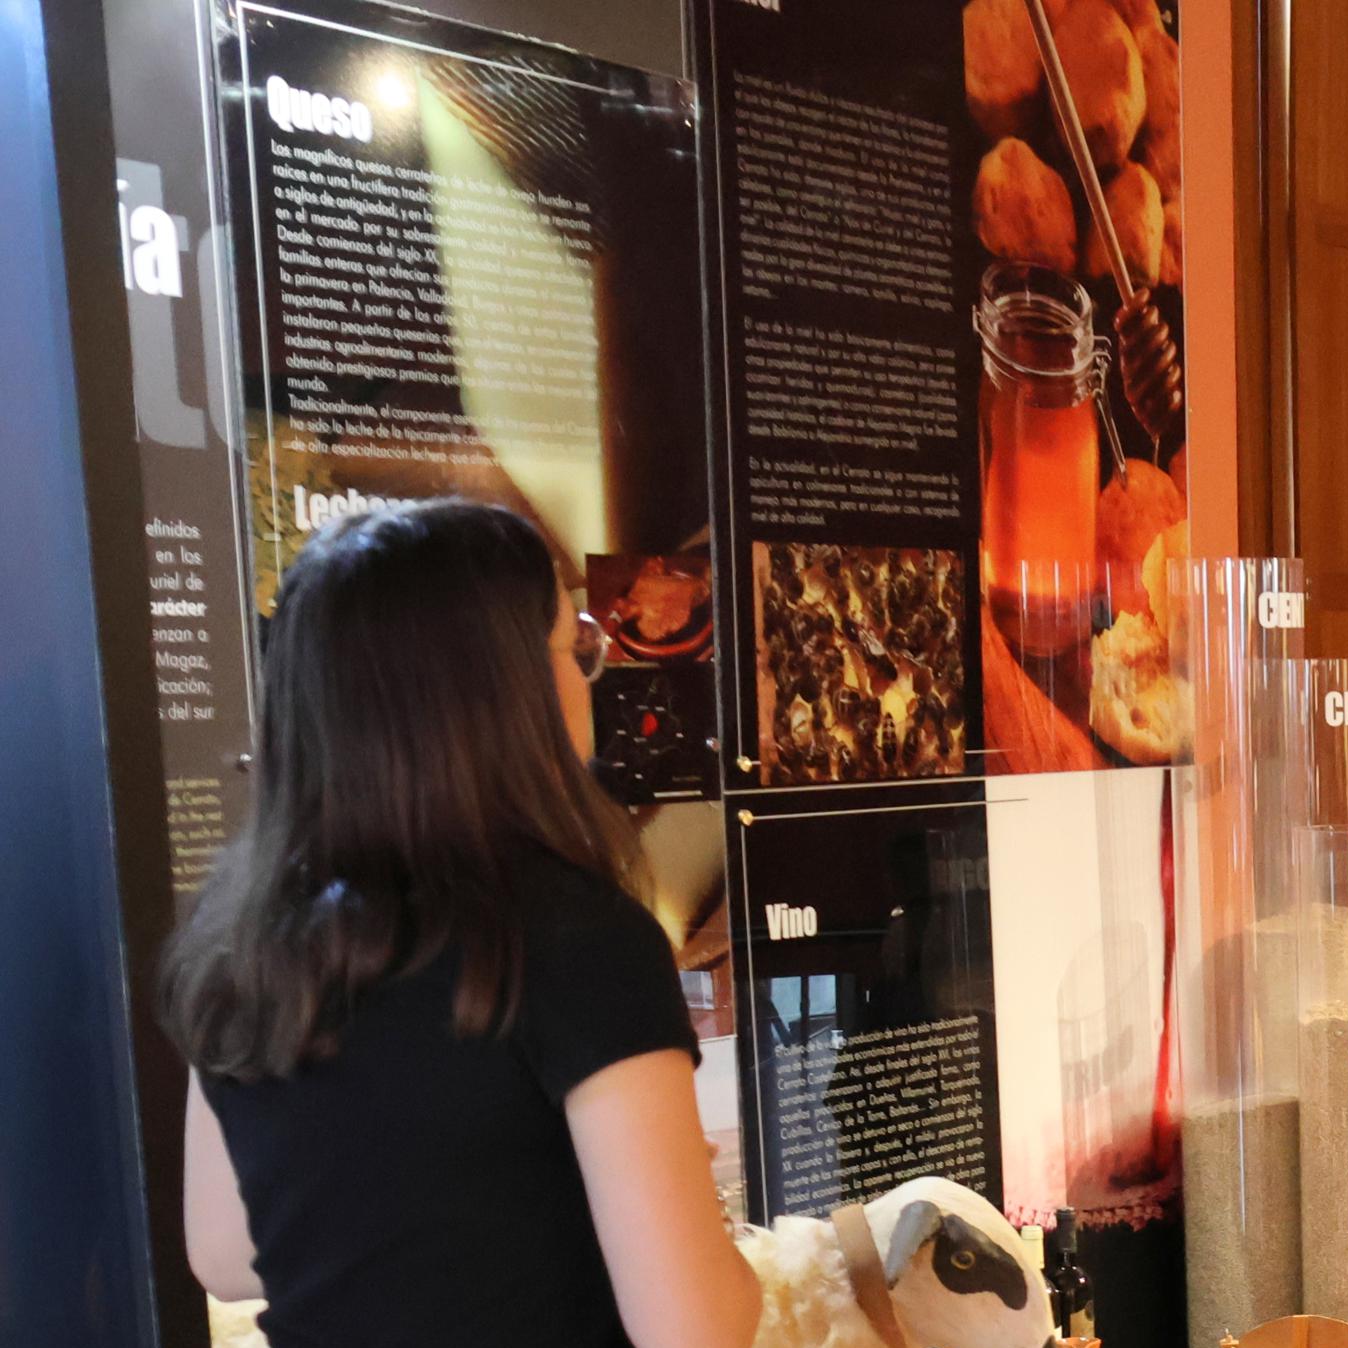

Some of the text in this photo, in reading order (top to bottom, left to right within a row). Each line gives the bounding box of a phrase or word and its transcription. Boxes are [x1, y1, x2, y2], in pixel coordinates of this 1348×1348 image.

[267, 75, 372, 143] Queso
[271, 139, 291, 158] Los
[356, 159, 393, 177] quesos
[539, 190, 572, 209] hunden
[310, 172, 324, 185] en
[328, 175, 348, 190] una
[286, 187, 319, 207] siglos
[320, 190, 334, 208] de
[409, 210, 421, 222] en
[424, 208, 433, 224] la
[276, 208, 290, 222] en
[295, 208, 306, 224] el
[311, 214, 360, 233] mercado
[364, 223, 382, 239] por
[386, 226, 398, 239] su
[278, 226, 313, 246] Desde
[317, 236, 374, 255] comienzos
[376, 241, 393, 258] del
[398, 247, 421, 265] siglo
[279, 247, 323, 268] familias
[325, 258, 363, 274] enteras
[366, 264, 386, 280] que
[281, 268, 293, 285] la
[295, 274, 351, 293] primavera
[353, 282, 365, 295] en
[284, 313, 338, 332] instalaron
[352, 299, 361, 314] A
[365, 304, 393, 320] partir
[397, 304, 410, 320] de
[415, 307, 429, 323] los
[285, 332, 331, 351] industrias
[335, 340, 414, 360] agroalimentarias
[286, 353, 459, 387] obtenido prestigiosos premios que
[288, 375, 327, 392] mundo.
[381, 402, 389, 417] el
[333, 418, 343, 433] la
[345, 419, 373, 435] leche
[376, 421, 389, 436] de
[392, 422, 402, 437] la
[293, 484, 418, 532] Lech
[155, 544, 204, 566] en los
[765, 903, 817, 940] Vino
